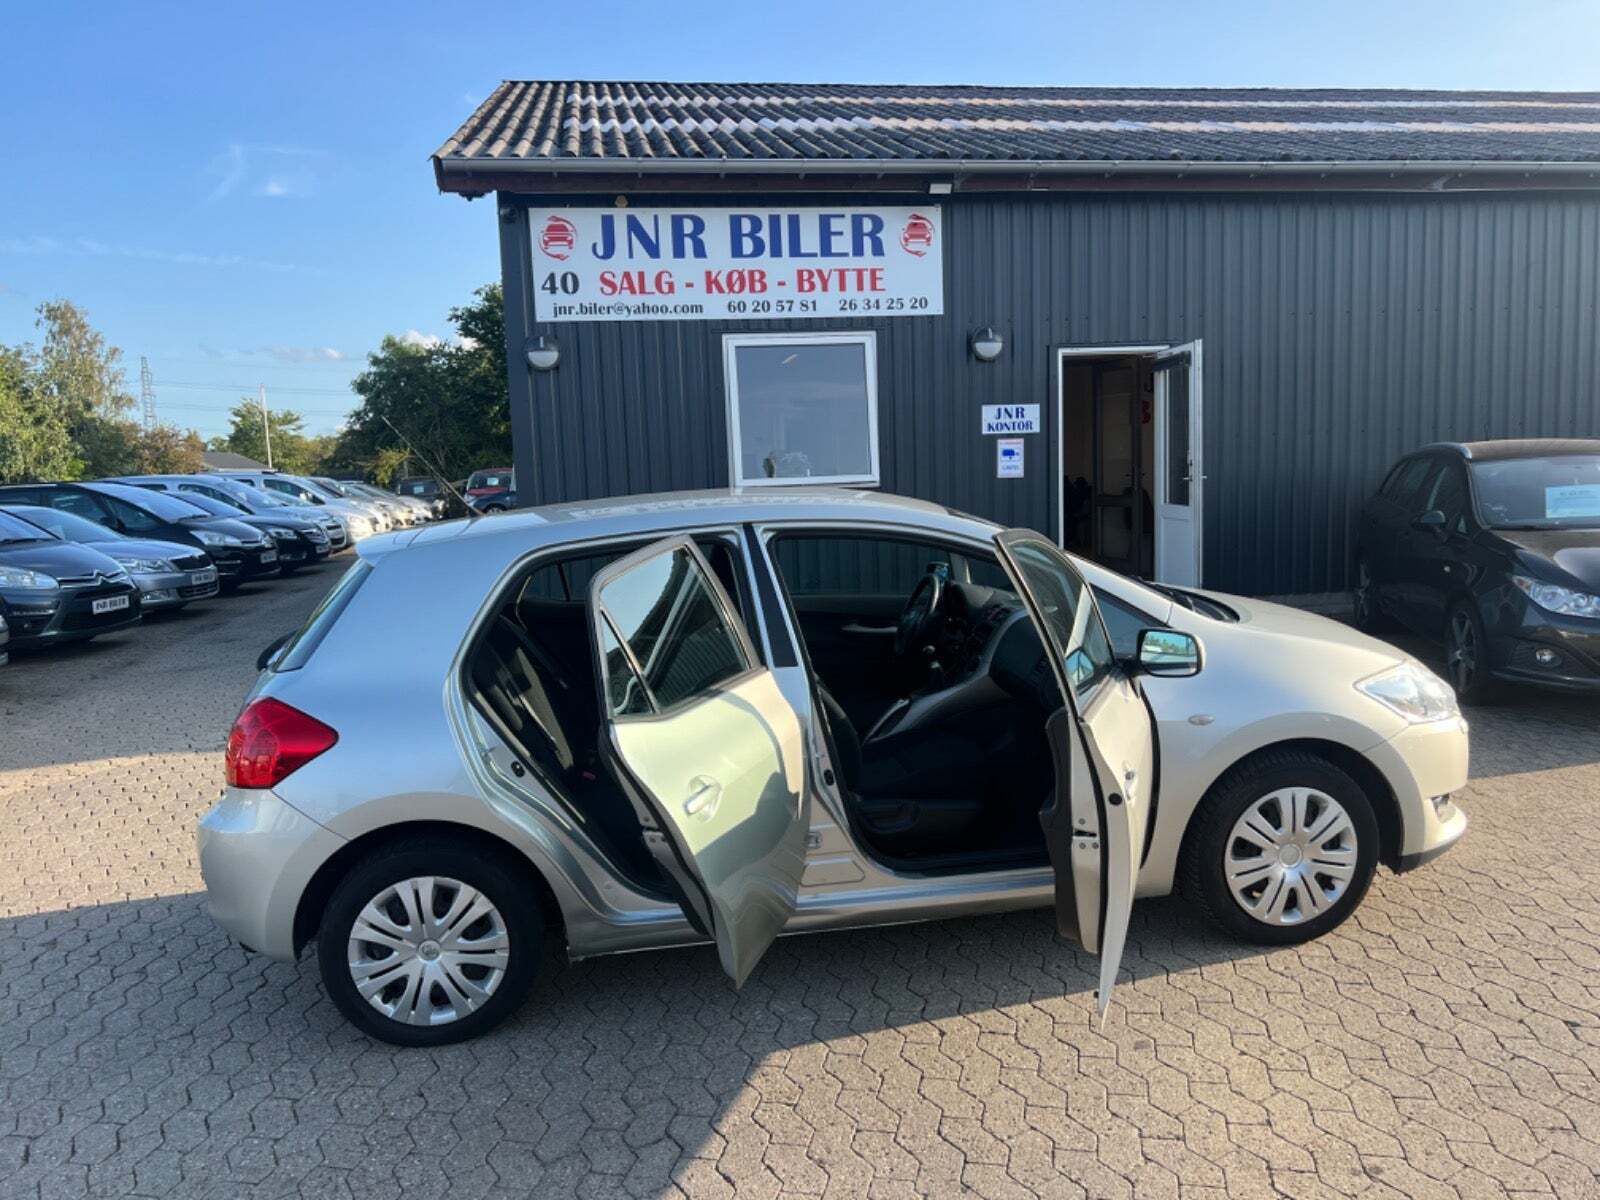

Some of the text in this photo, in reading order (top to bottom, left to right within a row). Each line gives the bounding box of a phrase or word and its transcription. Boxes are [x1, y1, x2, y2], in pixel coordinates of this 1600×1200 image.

[592, 213, 886, 260] JNR BILER
[541, 271, 580, 295] 40
[599, 270, 676, 296] SALG
[705, 268, 768, 295] KØB
[796, 267, 886, 293] BYTTE
[553, 296, 929, 319] jnr.biler@yahoo.com 60 20 57 81 26 34 25 20
[995, 406, 1025, 420] JNR
[987, 420, 1033, 433] KONTOR
